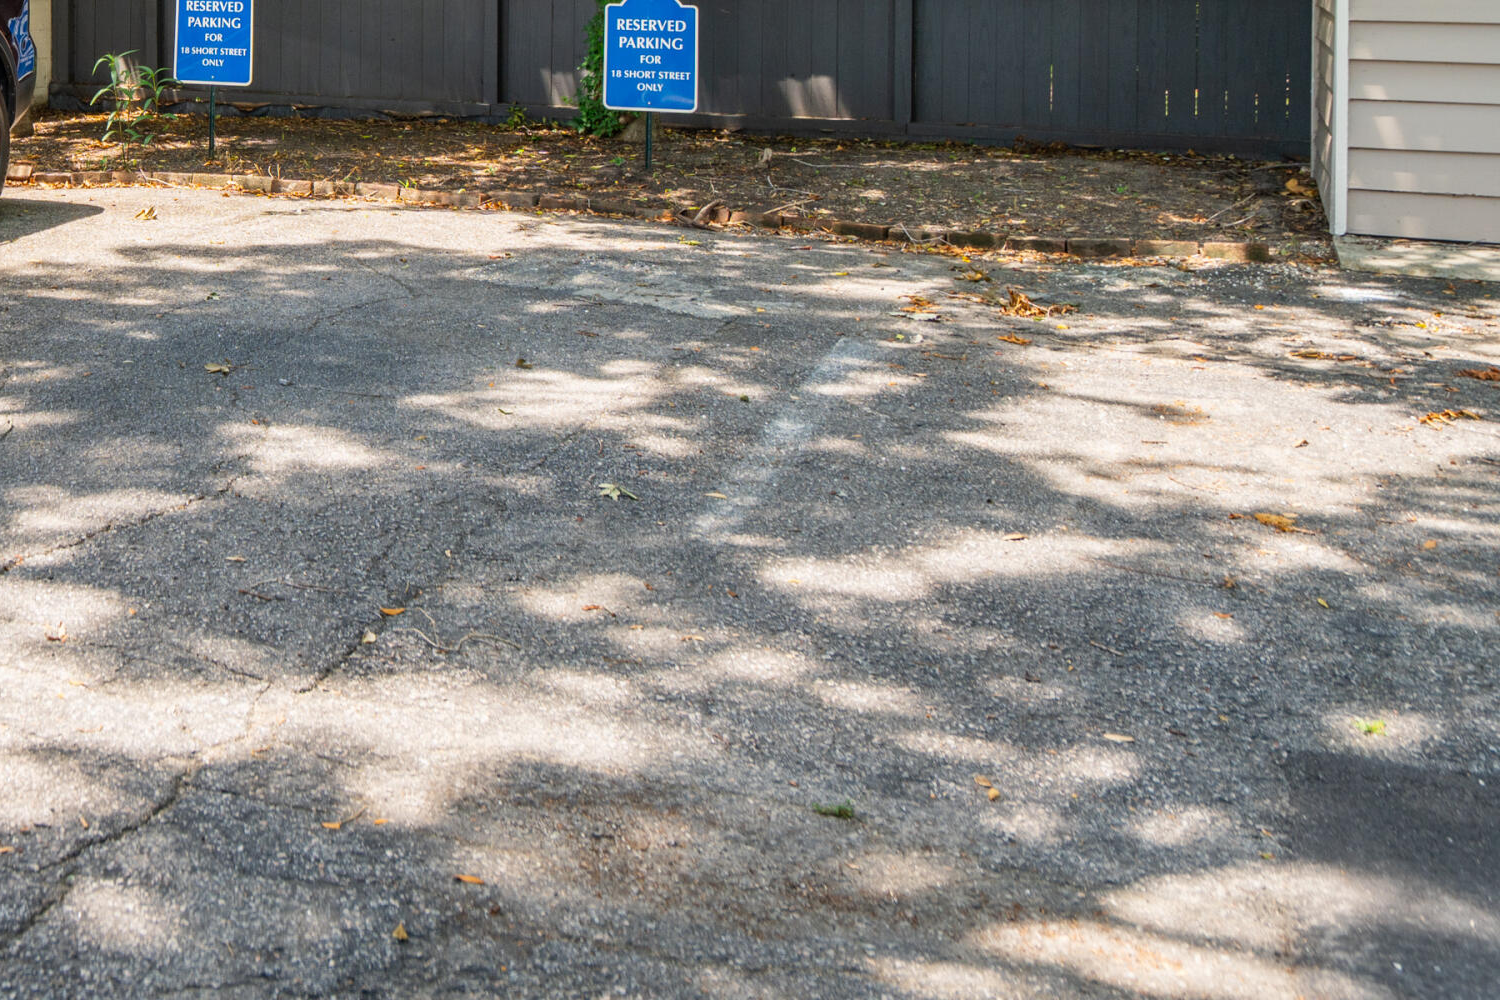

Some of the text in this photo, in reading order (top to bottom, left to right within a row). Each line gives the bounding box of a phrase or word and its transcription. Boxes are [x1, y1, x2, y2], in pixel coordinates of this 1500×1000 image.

[186, 0, 244, 12] RESERVED
[188, 16, 241, 28] PARKING
[617, 18, 686, 32] RESERVED
[204, 33, 223, 41] FOR
[619, 36, 683, 50] PARKING
[192, 47, 218, 55] SHORT
[220, 48, 247, 56] STREET
[202, 58, 224, 66] ONLY
[640, 55, 661, 64] FOR
[611, 69, 691, 80] 18 SHORT STREET
[637, 83, 663, 92] ONLY
